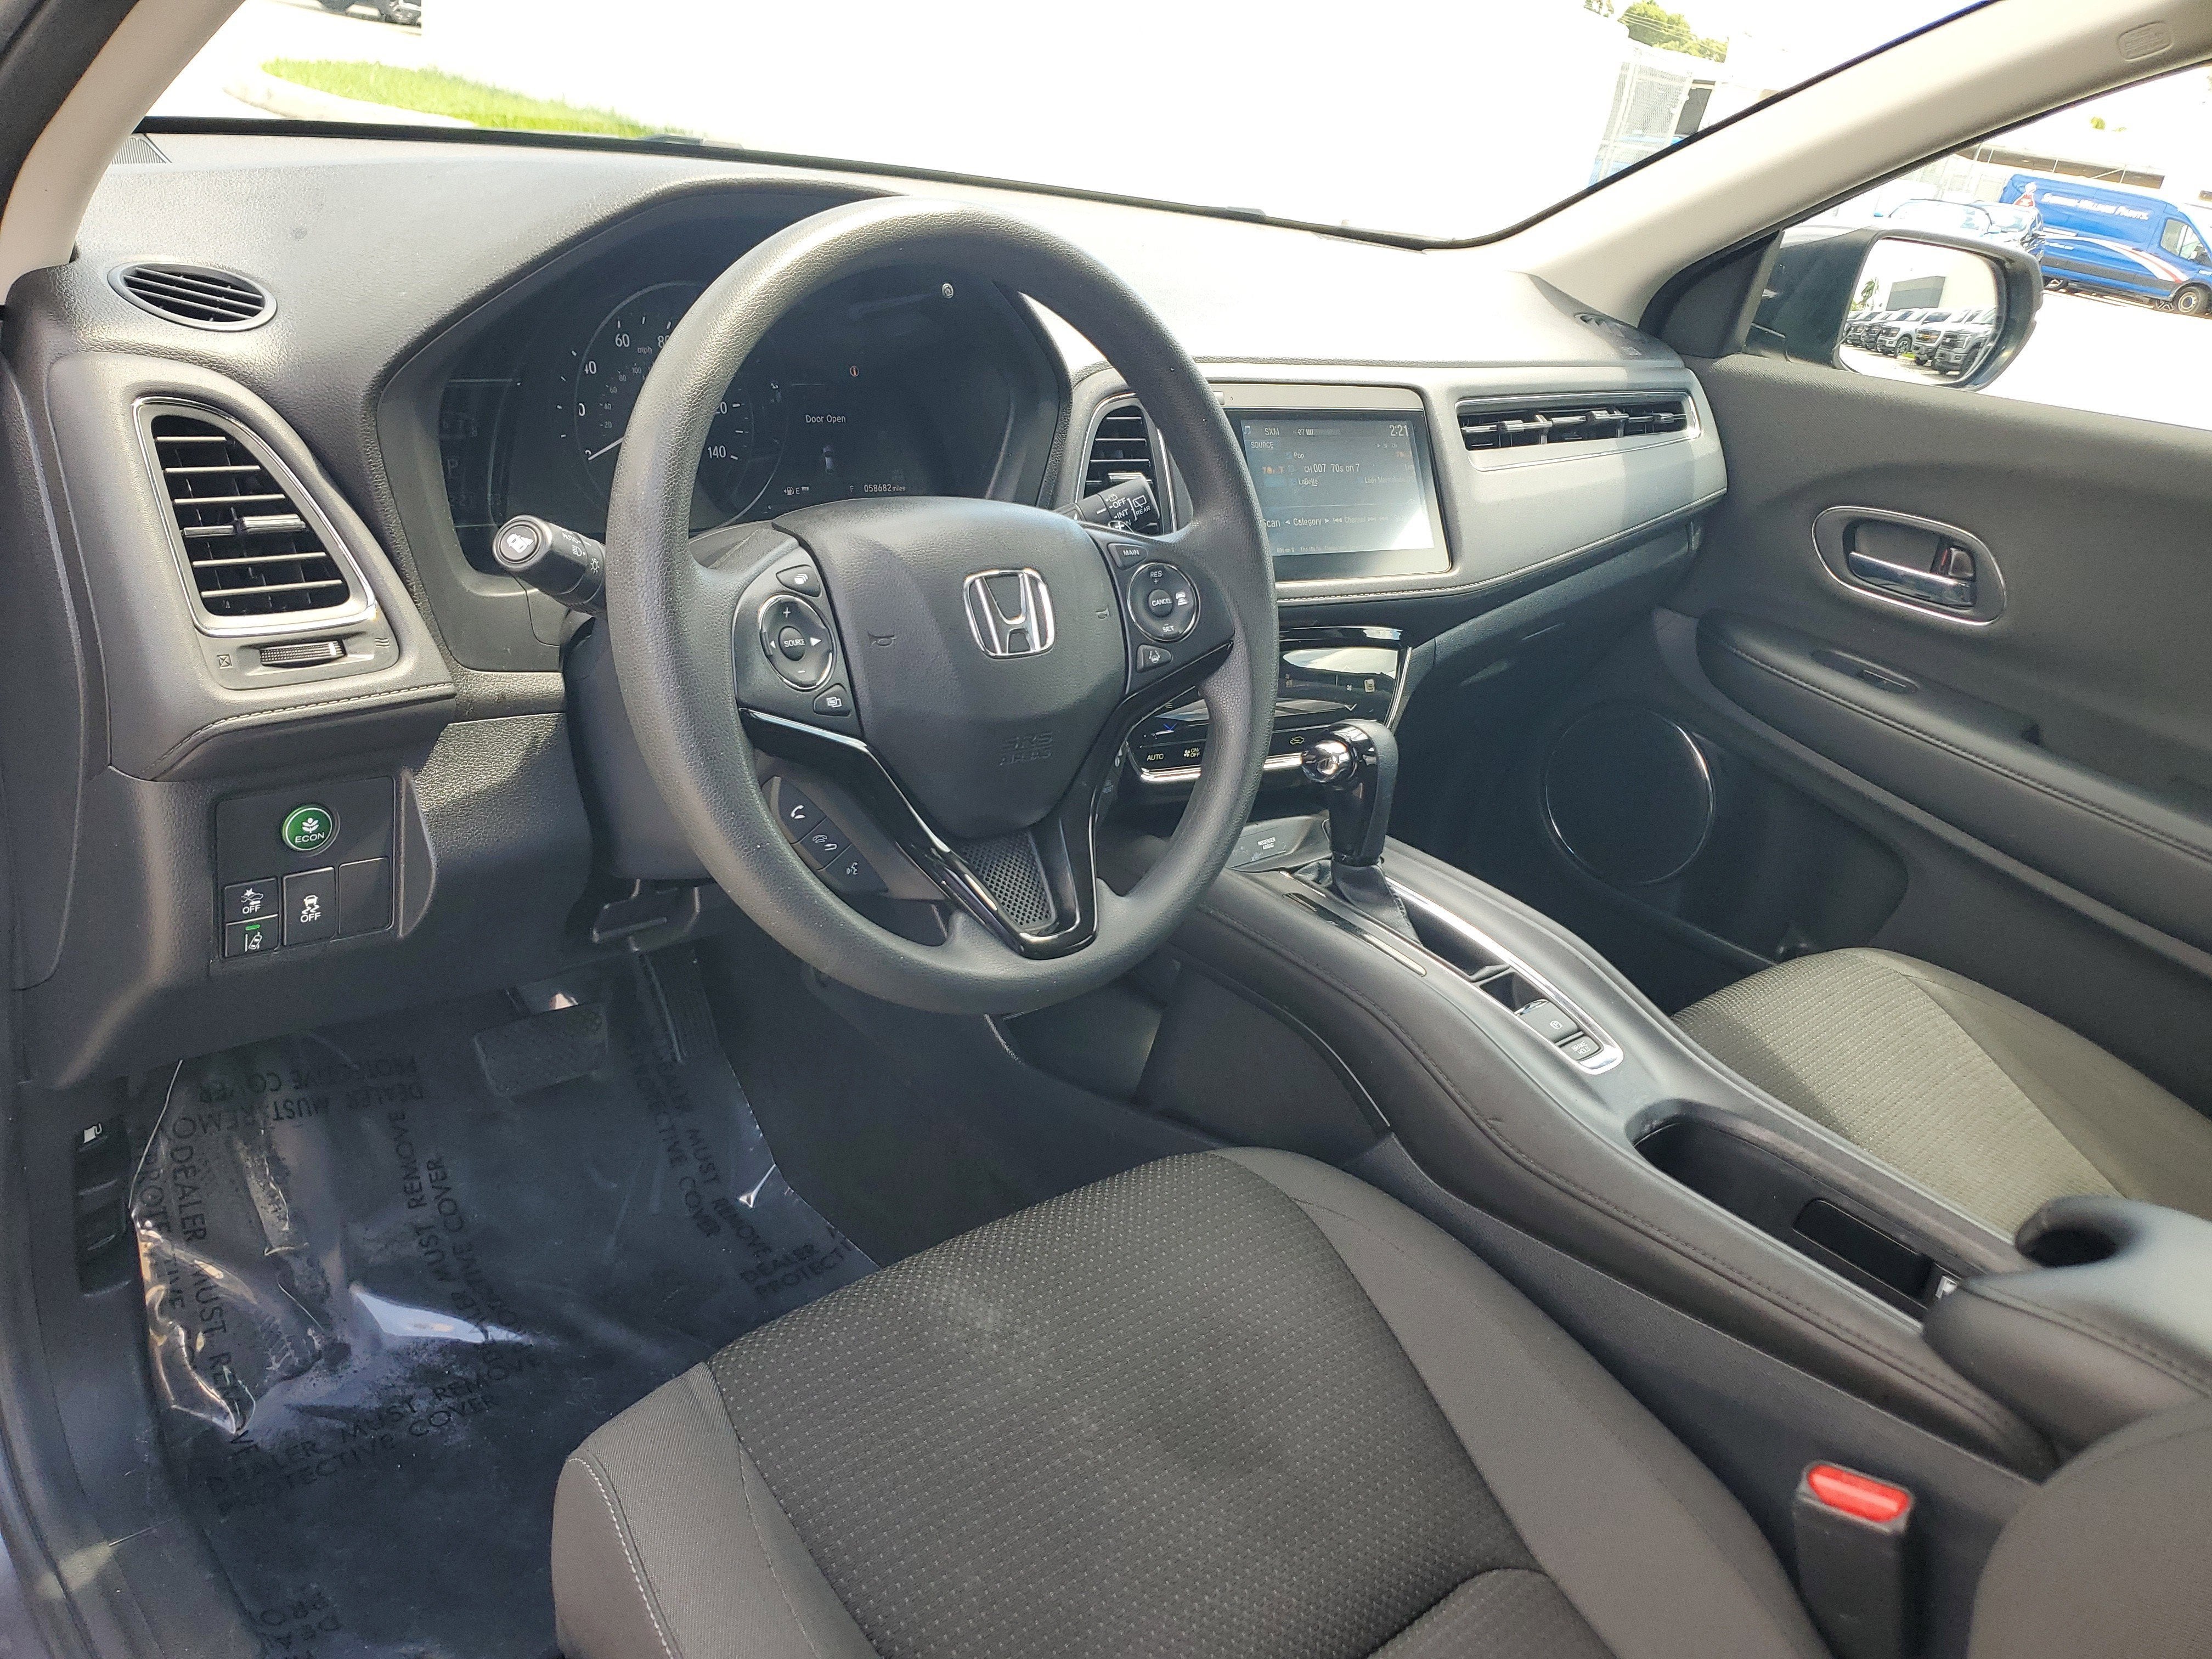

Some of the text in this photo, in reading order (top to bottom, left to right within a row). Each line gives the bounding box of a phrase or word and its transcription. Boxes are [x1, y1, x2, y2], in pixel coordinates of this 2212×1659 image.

[615, 334, 630, 347] 60
[637, 346, 653, 354] mph
[805, 414, 846, 425] Door Open
[1265, 427, 1280, 436] SXM
[1389, 424, 1409, 437] 2:21
[708, 445, 726, 459] 140
[1313, 464, 1326, 473] 007
[1330, 463, 1344, 472] 70s
[1356, 463, 1359, 472] 7
[864, 483, 892, 493] 058682
[1113, 497, 1126, 509] OFF
[1116, 508, 1128, 520] INT
[1136, 505, 1151, 516] REAR
[1293, 517, 1322, 527] Category
[1150, 570, 1163, 578] RES
[1152, 597, 1172, 607] CANCEL
[783, 638, 806, 647] SOURCE
[1147, 753, 1164, 761] AUTO
[295, 832, 325, 844] ECON
[242, 905, 261, 915] OFF
[300, 912, 321, 923] OFF
[387, 1109, 427, 1210] REMOVE
[170, 1146, 207, 1243] DEALER
[426, 1155, 466, 1234] COVER
